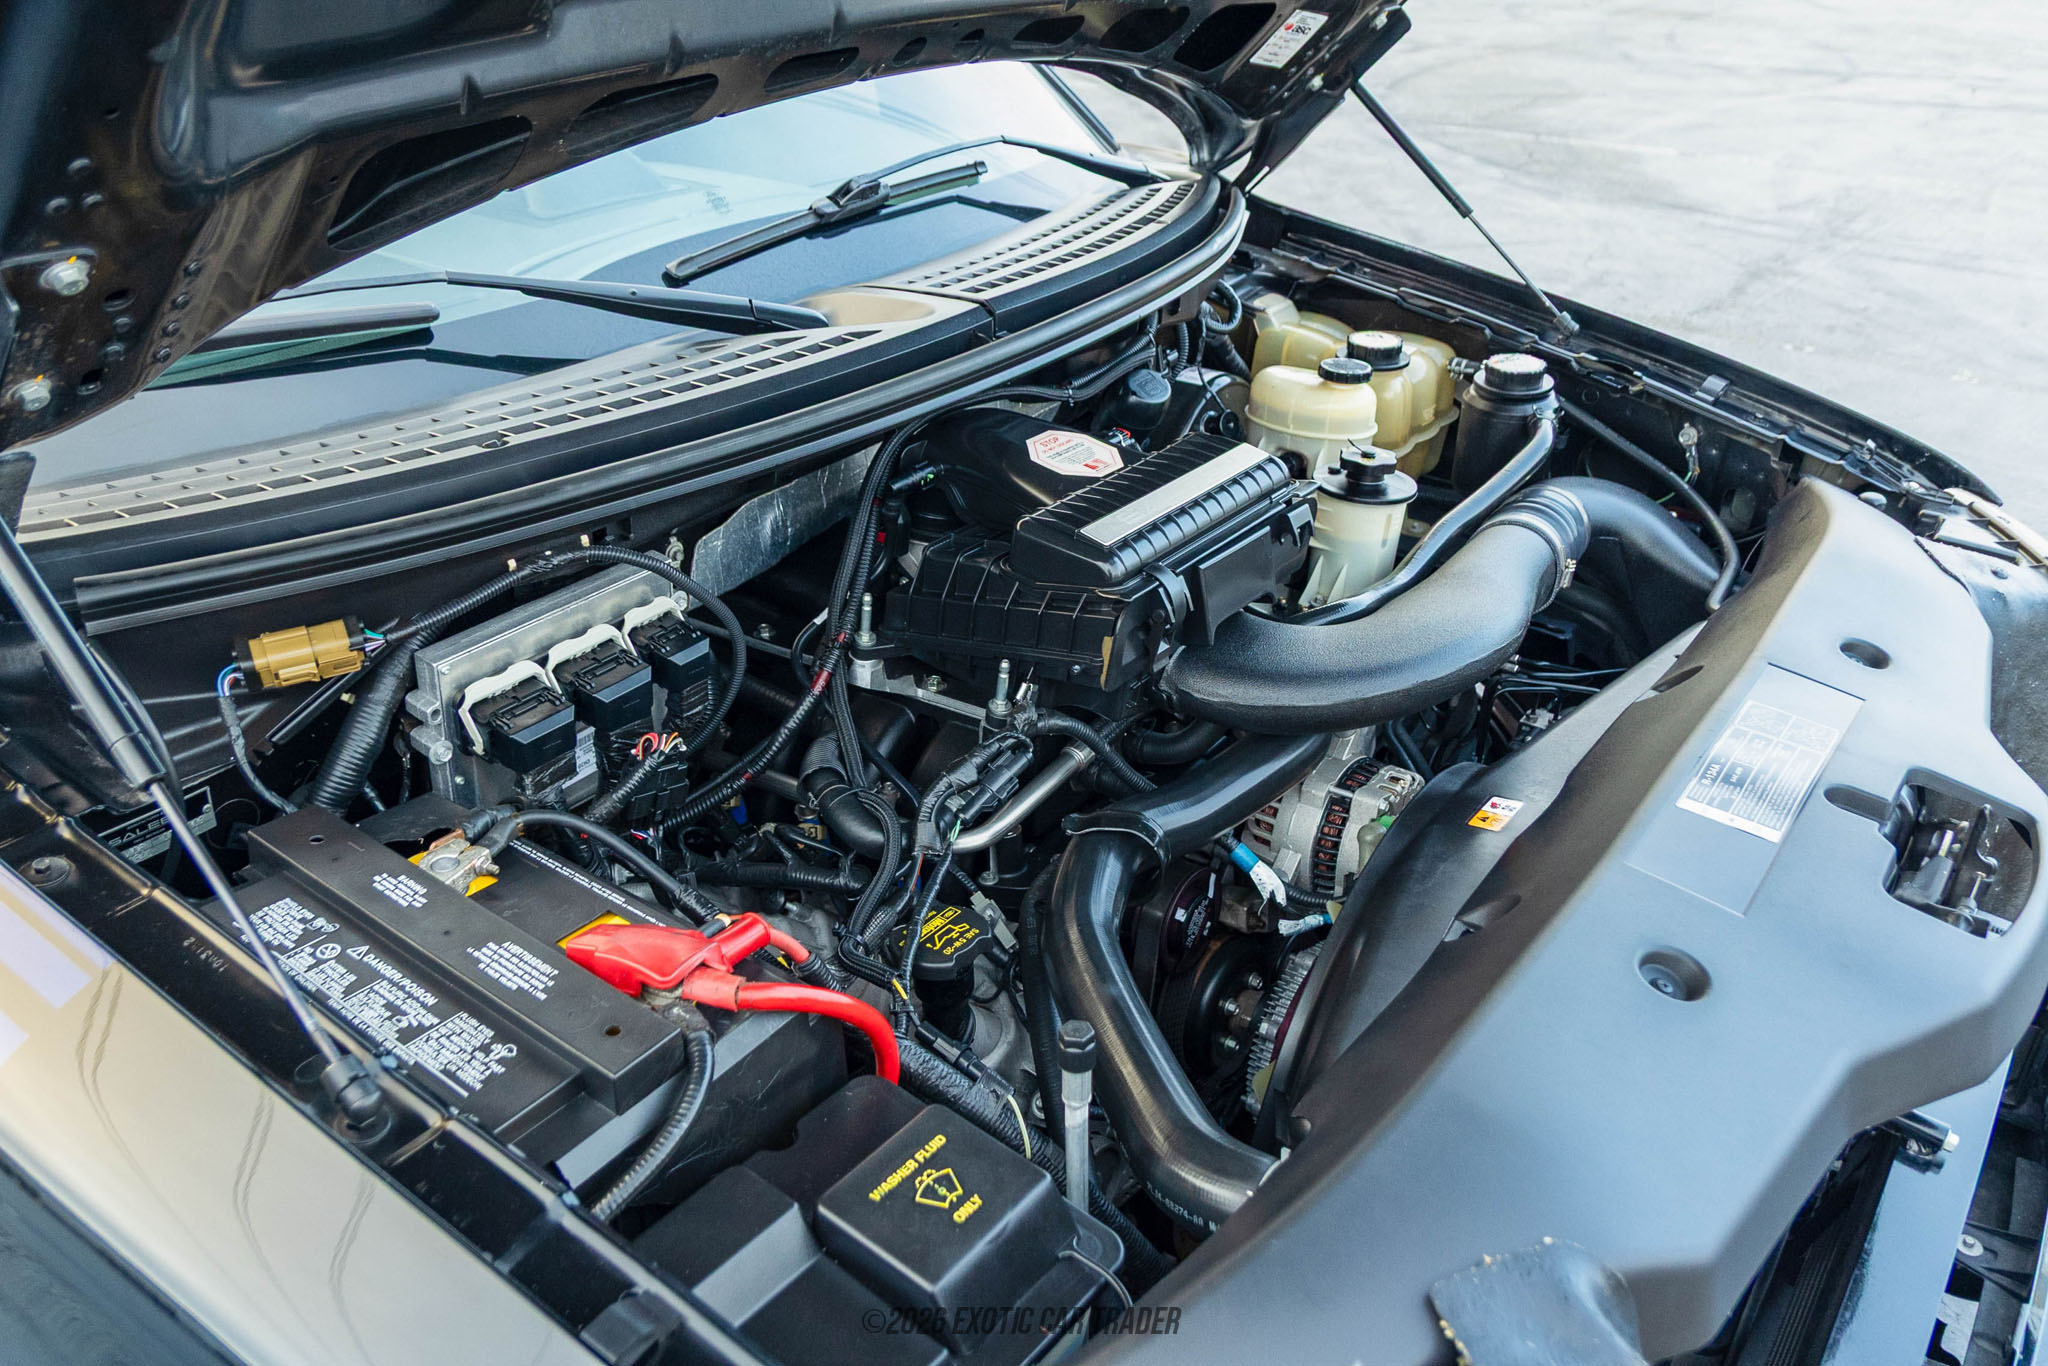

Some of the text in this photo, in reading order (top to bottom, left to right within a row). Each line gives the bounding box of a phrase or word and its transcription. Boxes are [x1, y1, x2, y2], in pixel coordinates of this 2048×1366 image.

[1040, 436, 1059, 448] STOP
[108, 816, 169, 847] SALEE
[942, 928, 980, 955] SAE 5W-20
[362, 953, 440, 1007] DANGER/POISON
[868, 1134, 947, 1202] WASHER FLUID
[953, 1194, 983, 1224] ONLY
